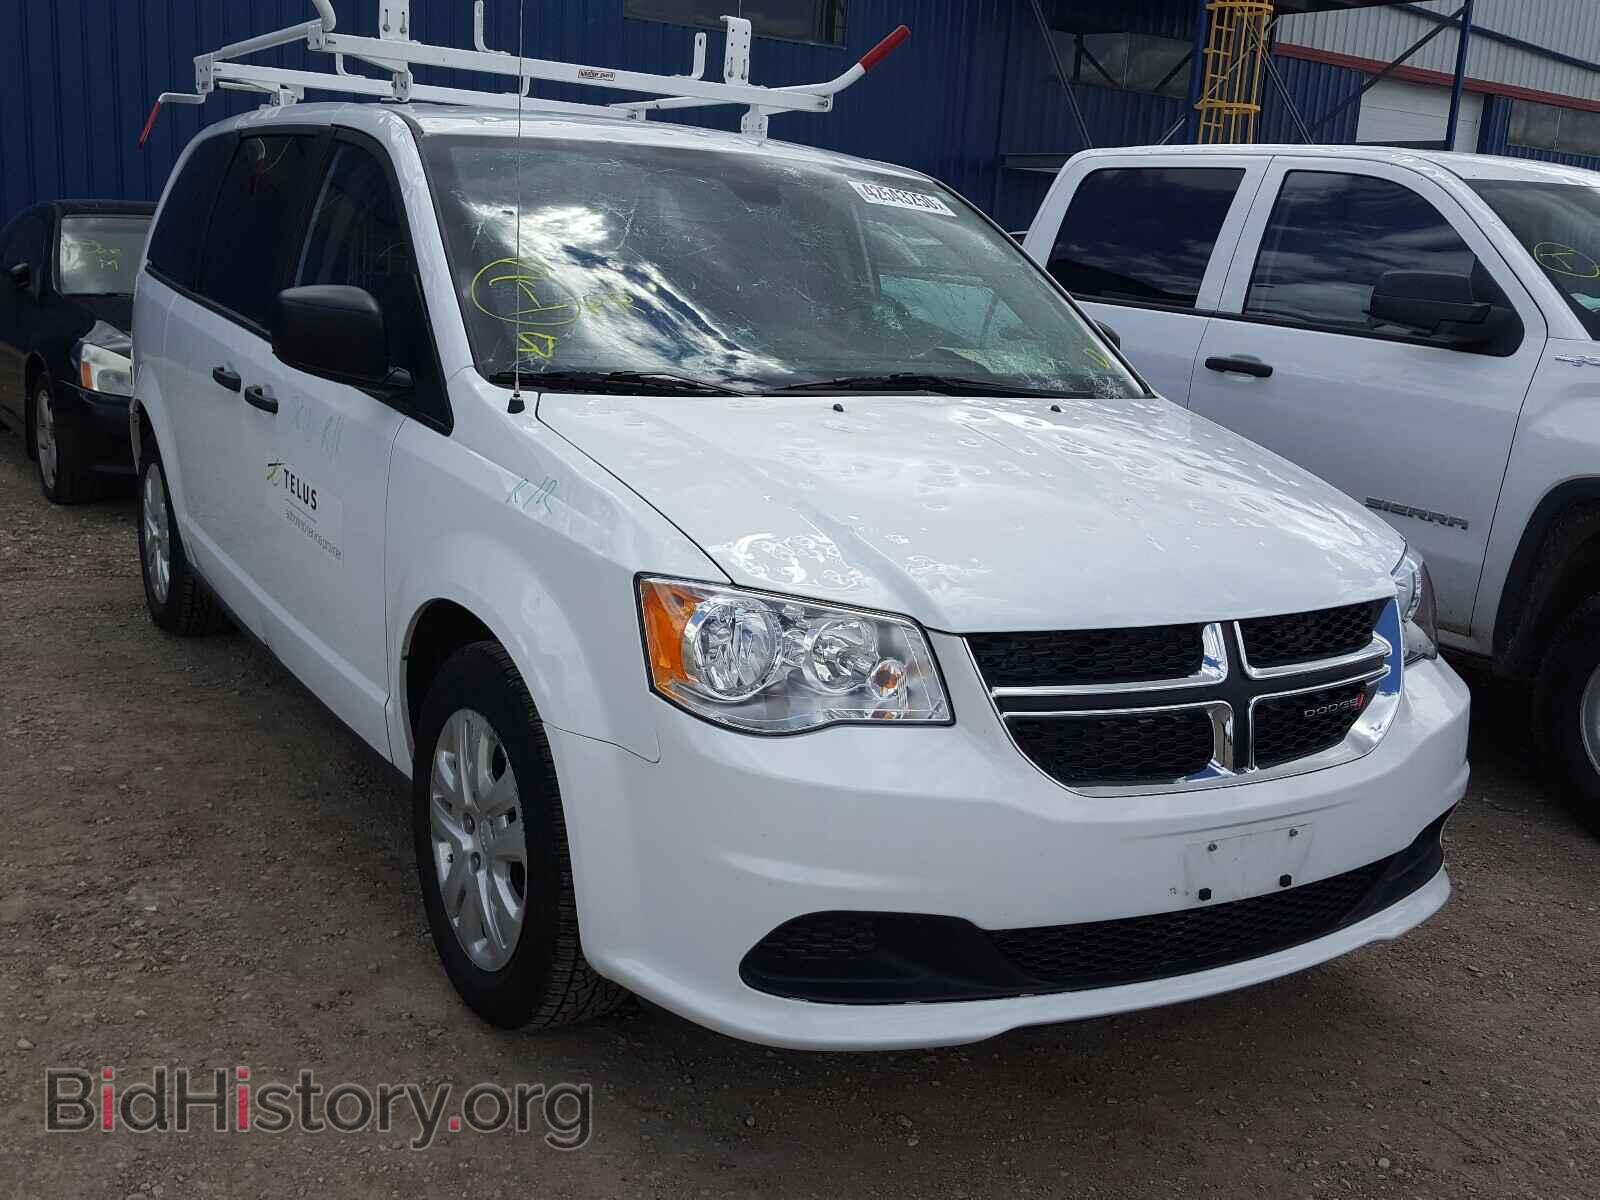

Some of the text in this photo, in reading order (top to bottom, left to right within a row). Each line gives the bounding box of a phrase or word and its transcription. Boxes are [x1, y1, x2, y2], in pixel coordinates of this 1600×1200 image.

[283, 467, 318, 511] TELUS
[1364, 496, 1469, 531] SIERRA
[1303, 696, 1360, 718] DODGE
